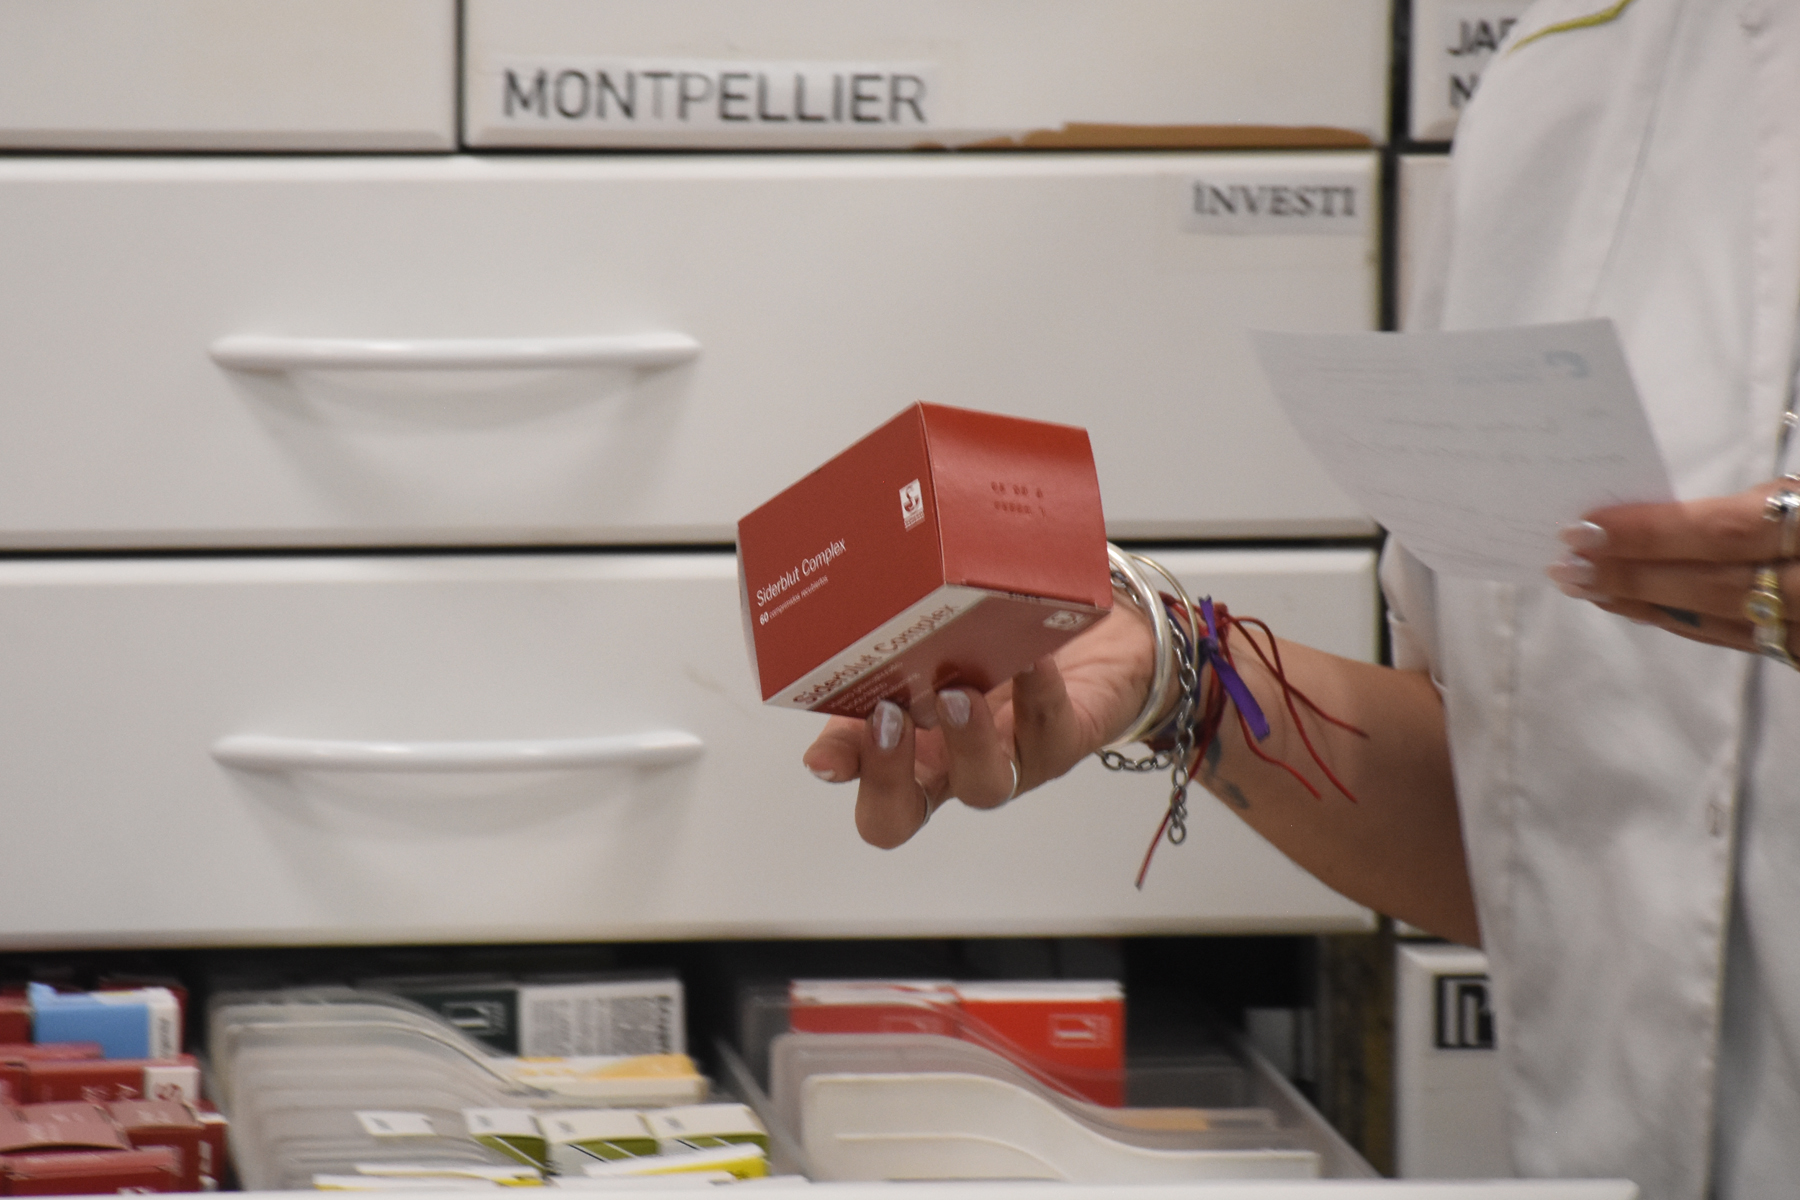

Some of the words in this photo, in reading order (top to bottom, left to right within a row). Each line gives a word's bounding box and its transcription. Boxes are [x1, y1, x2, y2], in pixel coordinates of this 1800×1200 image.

[502, 69, 927, 124] MONTPELLIER
[1193, 183, 1355, 216] INVESTI
[756, 566, 800, 607] Siderblut
[801, 538, 846, 576] Complex
[759, 611, 769, 625] 60
[874, 603, 959, 652] Complex
